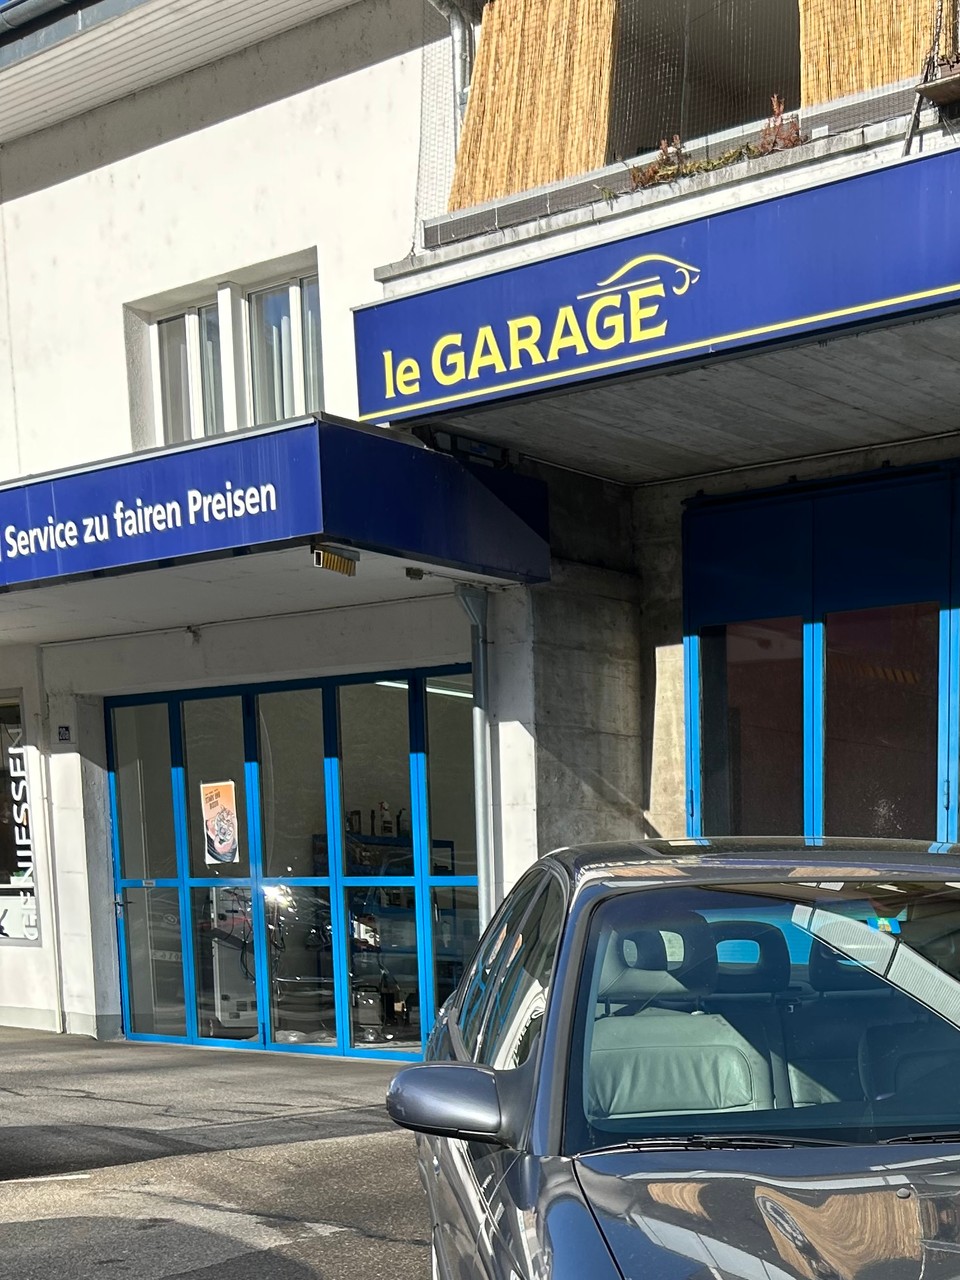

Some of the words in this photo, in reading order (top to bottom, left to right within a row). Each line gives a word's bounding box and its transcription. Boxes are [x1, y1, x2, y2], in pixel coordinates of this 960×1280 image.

[382, 349, 421, 399] le
[431, 283, 668, 386] GARAGE
[4, 515, 78, 558] Service
[82, 515, 110, 544] zu
[113, 498, 181, 538] fairen
[187, 481, 277, 525] Preisen
